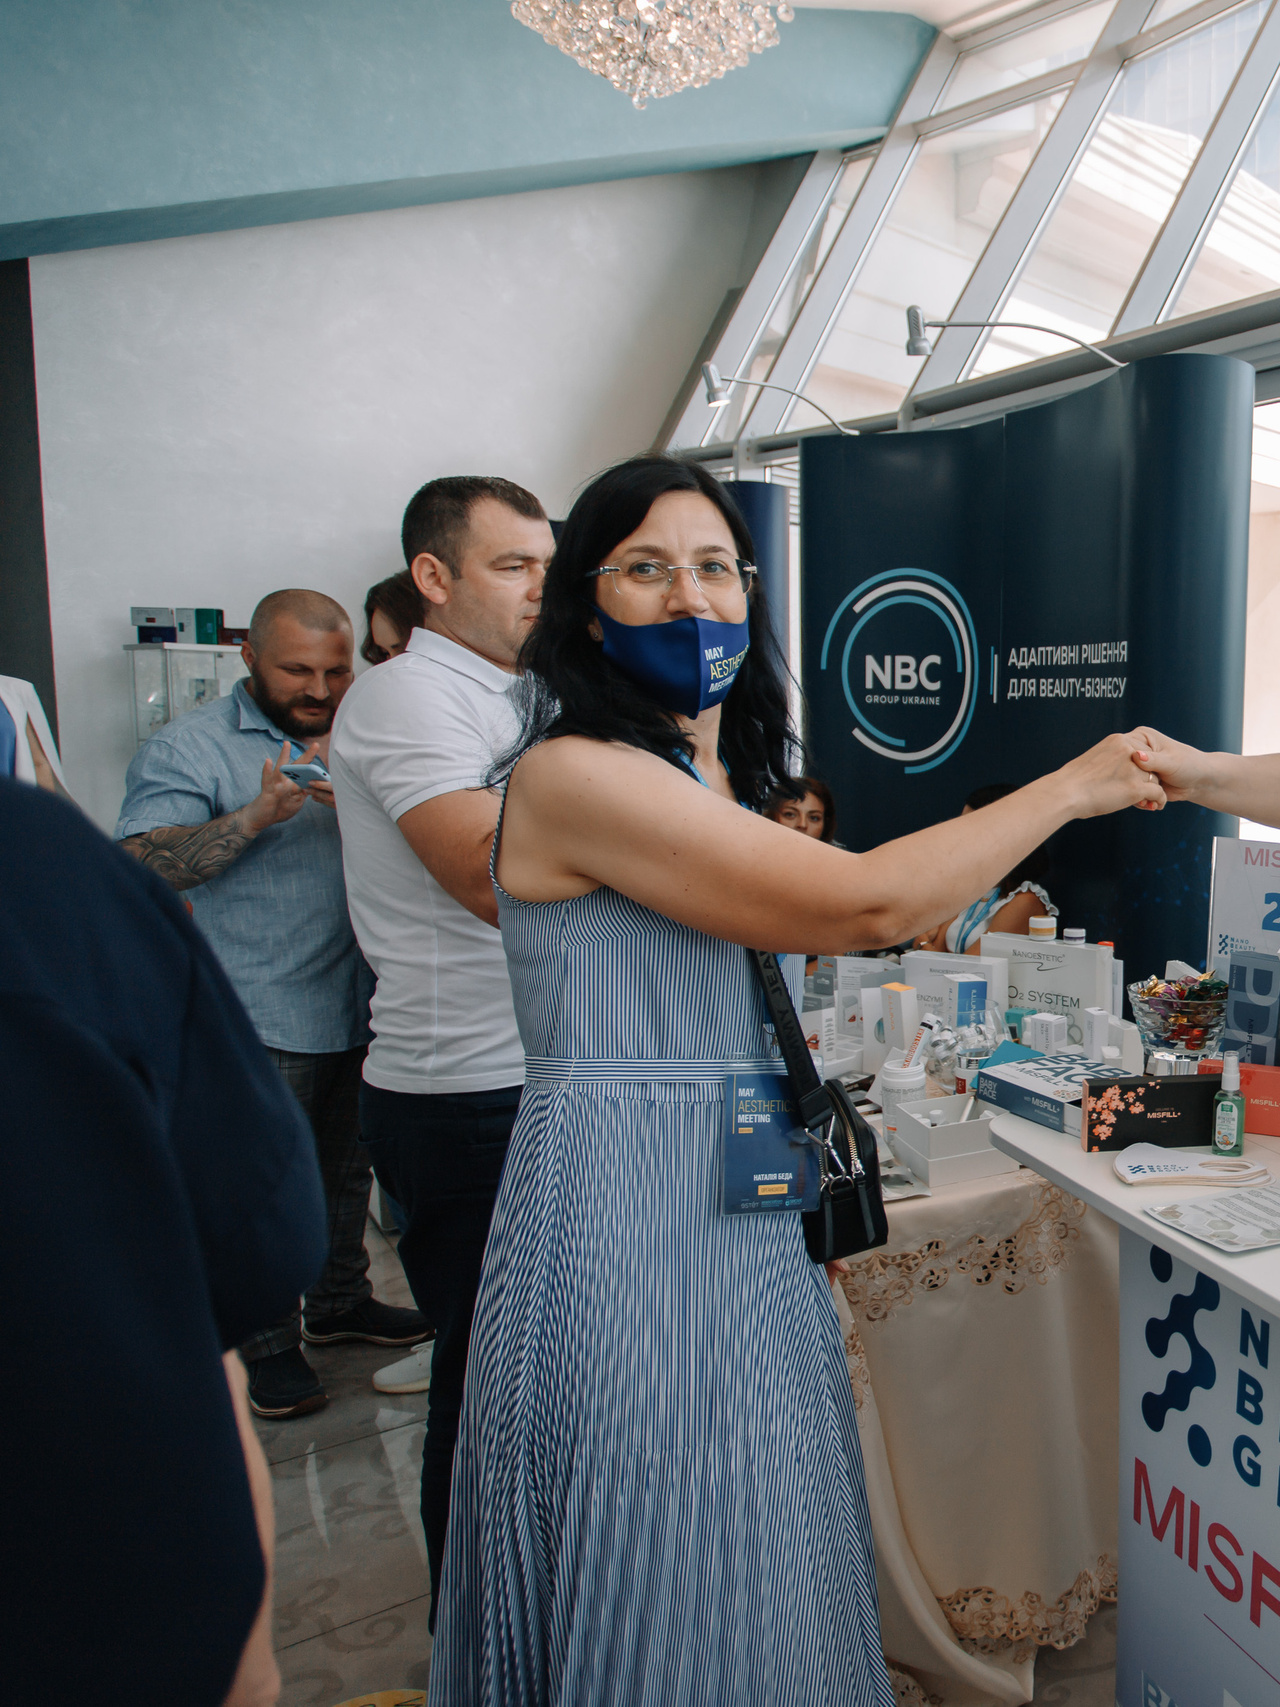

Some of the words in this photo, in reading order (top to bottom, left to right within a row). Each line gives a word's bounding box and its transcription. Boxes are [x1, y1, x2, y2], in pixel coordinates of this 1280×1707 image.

[705, 646, 724, 661] MAY
[1008, 645, 1080, 670] АДАПТИВНІ
[1081, 641, 1128, 665] РІШЕННЯ
[865, 655, 942, 690] NBC
[1007, 678, 1036, 700] ДЛЯ
[1039, 677, 1127, 699] BEAUTY-БІЗНЕСУ
[865, 694, 900, 705] GROUP
[901, 696, 941, 706] UKRAINE
[1230, 937, 1249, 945] NANO
[1028, 990, 1080, 1008] SYSTEM
[1016, 1056, 1095, 1086] FAC
[979, 1076, 998, 1090] BABY
[738, 1088, 755, 1097] MAY
[979, 1085, 997, 1100] FACE
[1031, 1096, 1060, 1114] MISFILL+
[737, 1114, 771, 1124] MEETING
[753, 1173, 777, 1181] НАТАЛІЯ
[777, 1172, 793, 1180] БЕДА
